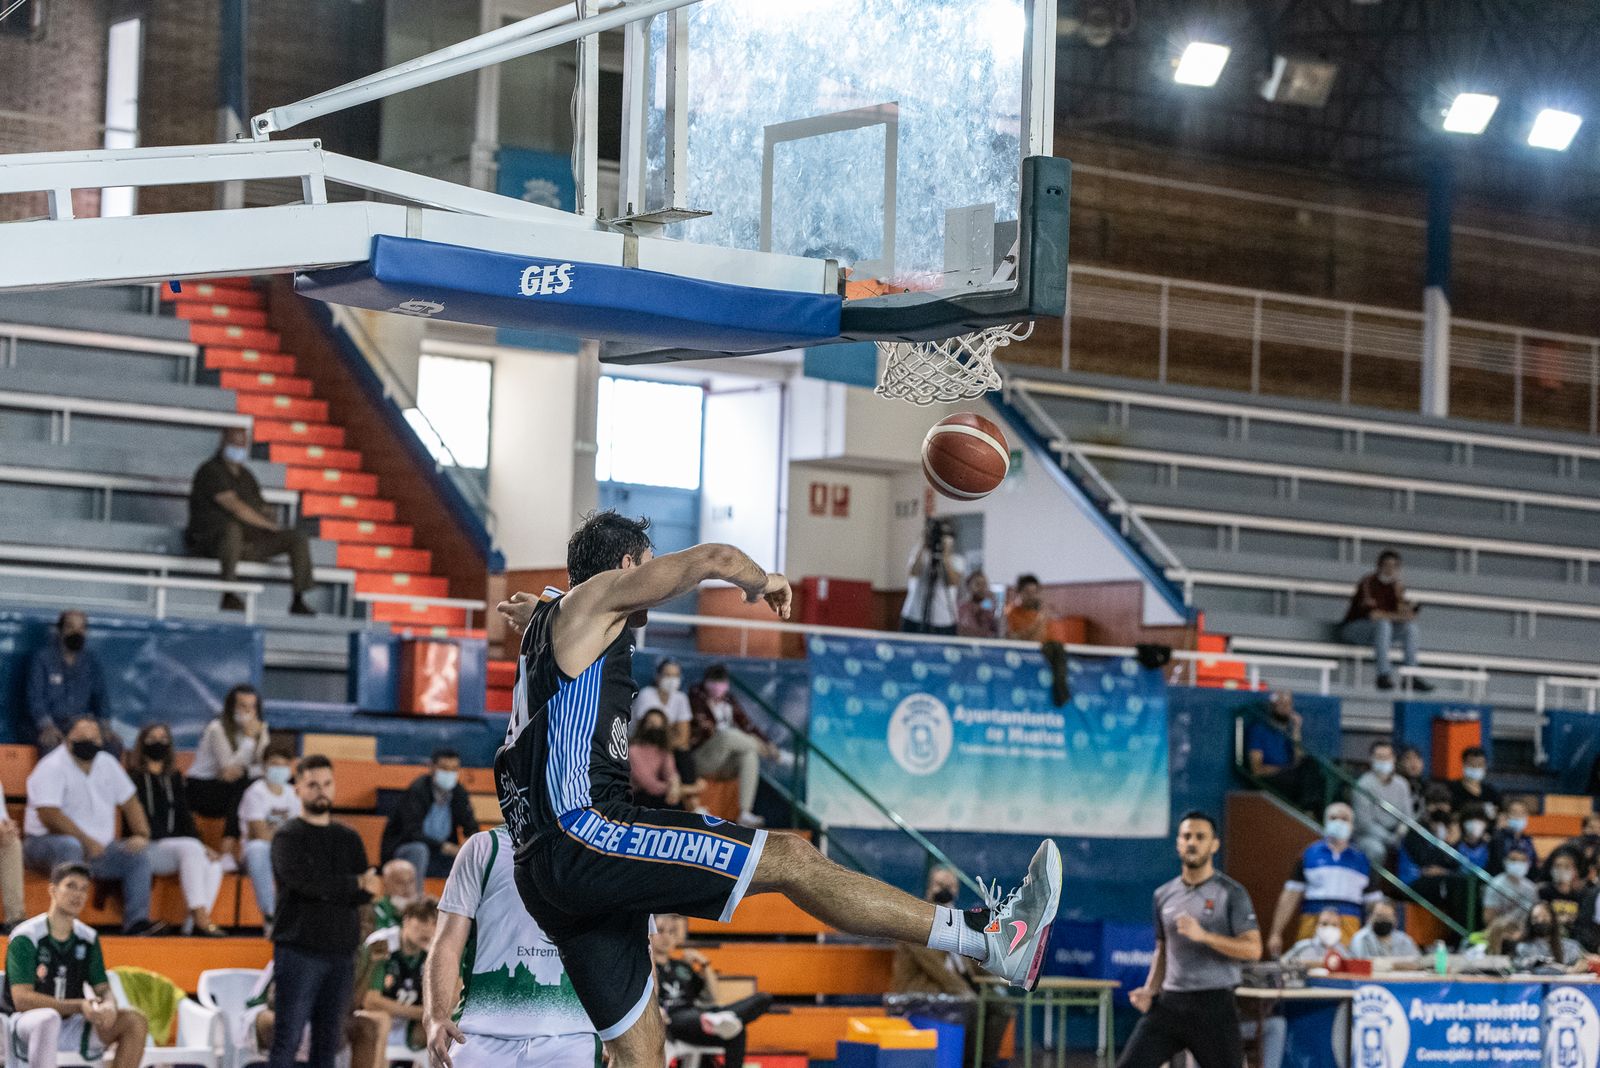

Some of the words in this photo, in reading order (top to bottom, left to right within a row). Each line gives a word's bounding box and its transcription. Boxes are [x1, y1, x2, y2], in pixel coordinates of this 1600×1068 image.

[518, 263, 575, 296] GES
[626, 826, 736, 871] ENRIQUE
[516, 946, 560, 957] Extrem
[1409, 998, 1540, 1025] Ayuntamiento
[1446, 1022, 1471, 1043] de
[1475, 1022, 1540, 1044] Huelva
